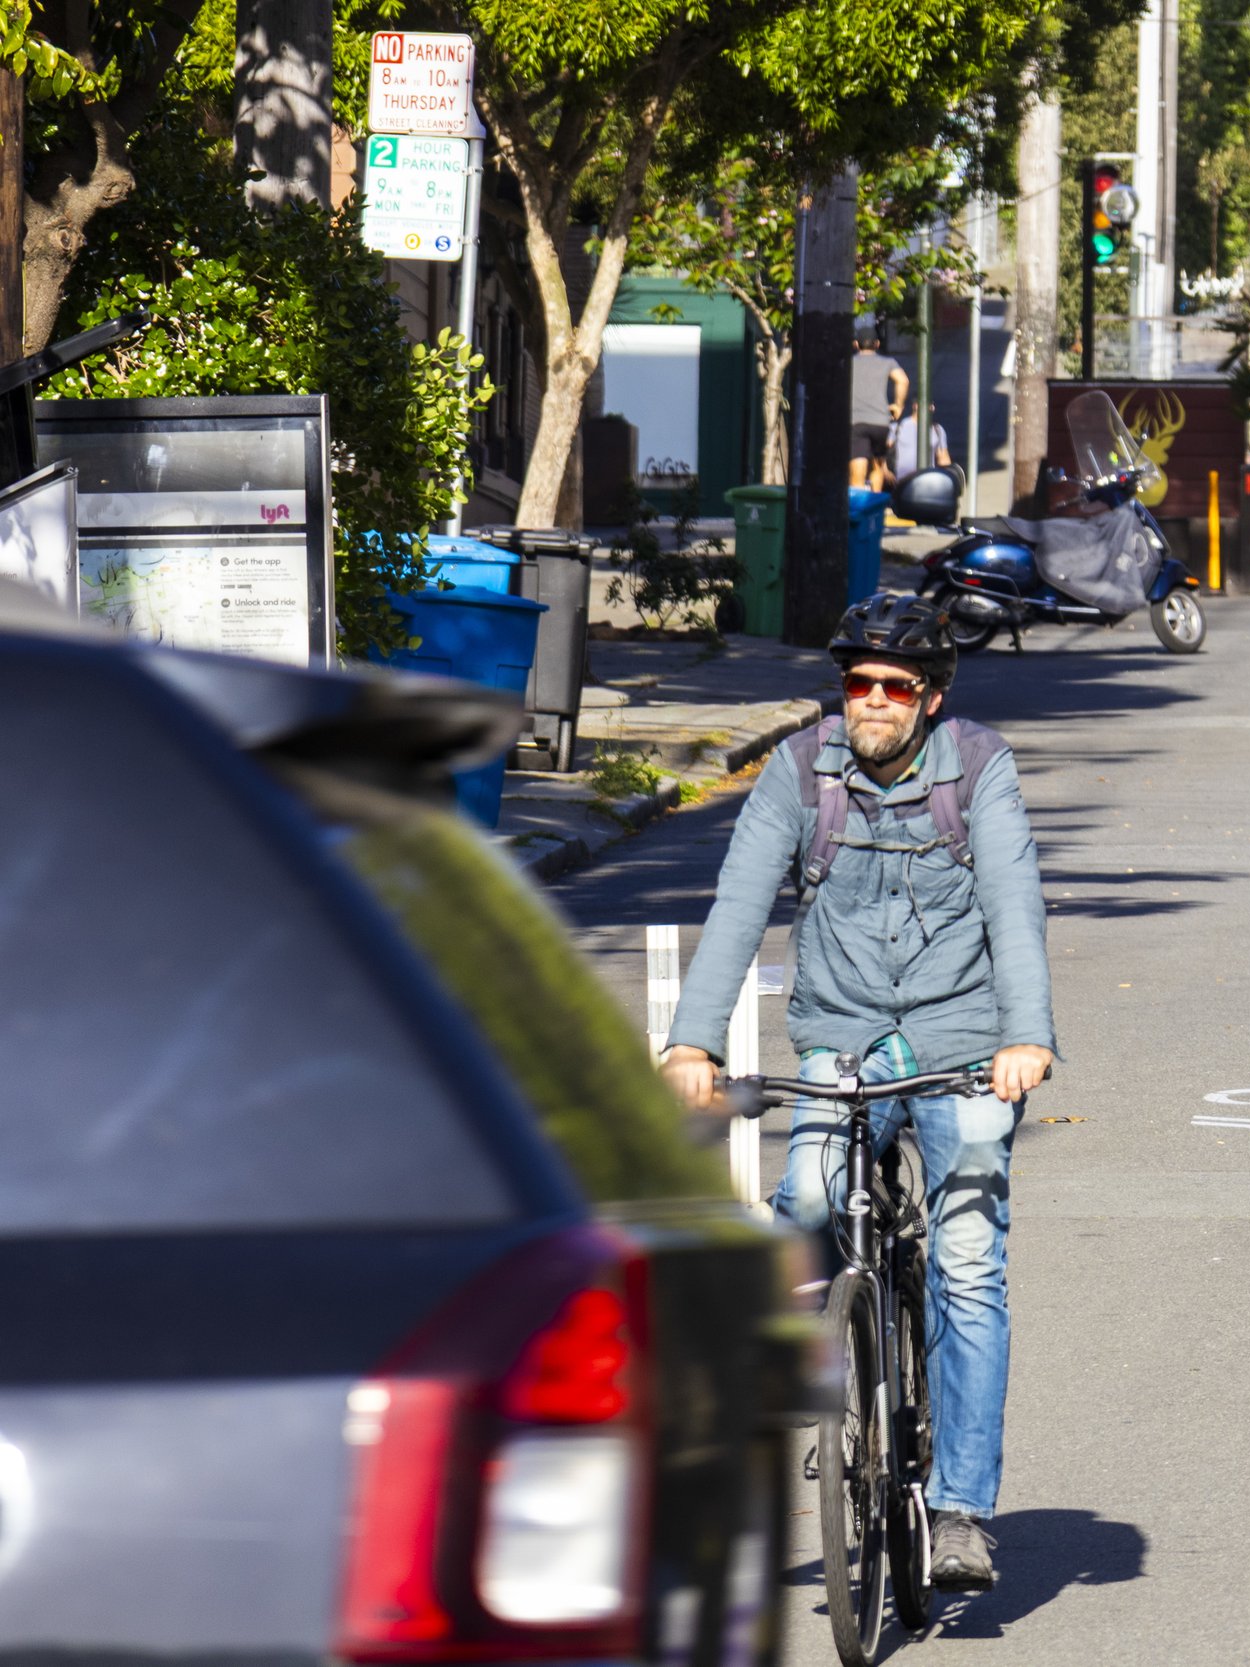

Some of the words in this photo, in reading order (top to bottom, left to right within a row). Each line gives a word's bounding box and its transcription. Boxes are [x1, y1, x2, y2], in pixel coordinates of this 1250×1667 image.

[376, 35, 400, 61] NO
[408, 43, 465, 62] PARKING
[383, 93, 456, 111] THURSDAY
[378, 117, 411, 127] STREET
[373, 140, 393, 165] 2
[413, 142, 452, 155] HOUR
[402, 158, 461, 173] PARKING
[374, 199, 400, 212] MON
[434, 203, 454, 215] FRI
[261, 503, 290, 525] lyft
[234, 557, 249, 565] Get
[251, 557, 263, 565] the
[265, 559, 281, 567] app
[234, 598, 261, 607] Unlock
[263, 598, 279, 606] and
[281, 598, 296, 606] ride
